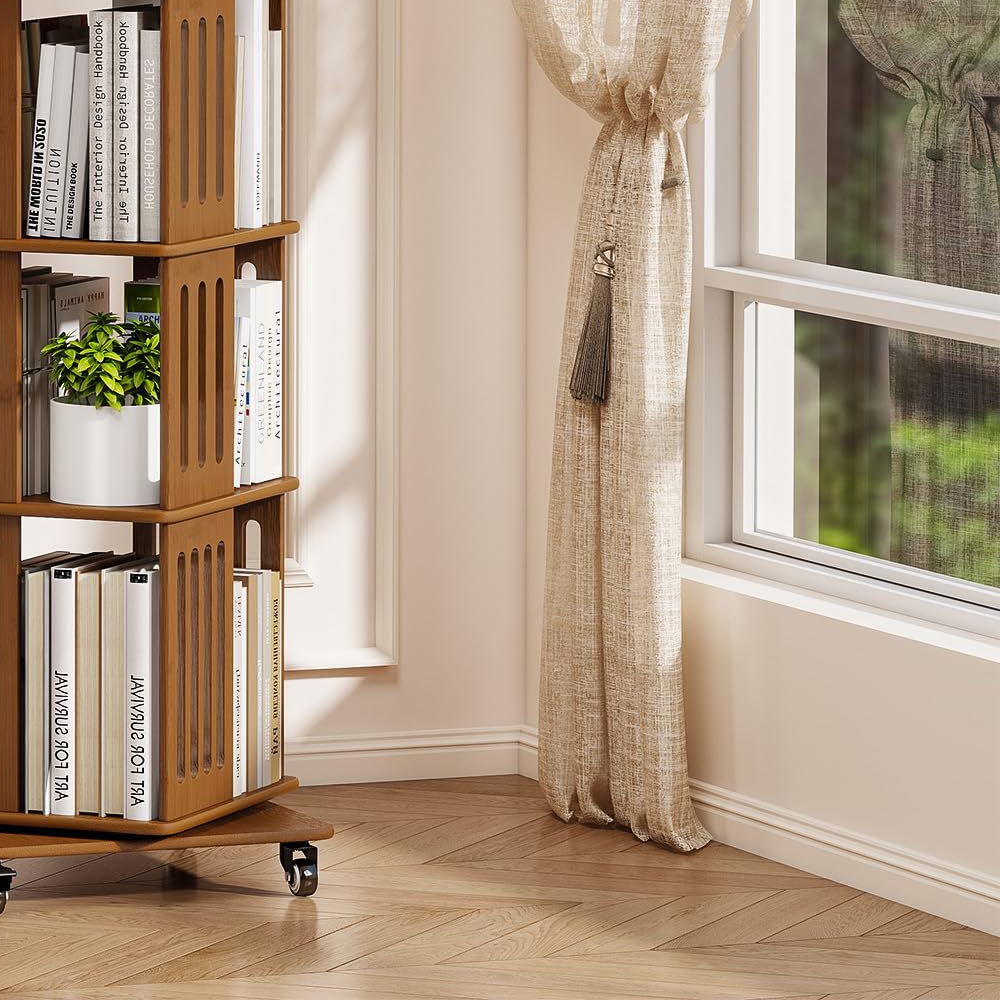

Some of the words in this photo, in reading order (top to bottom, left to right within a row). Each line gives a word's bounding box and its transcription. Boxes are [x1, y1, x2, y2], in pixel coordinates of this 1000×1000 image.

[94, 20, 103, 78] Handbook
[94, 85, 106, 129] Design
[69, 162, 78, 184] BOOK
[94, 136, 102, 192] Interior
[67, 185, 76, 215] DESIGN
[94, 201, 102, 222] The
[235, 344, 248, 465] Architectural
